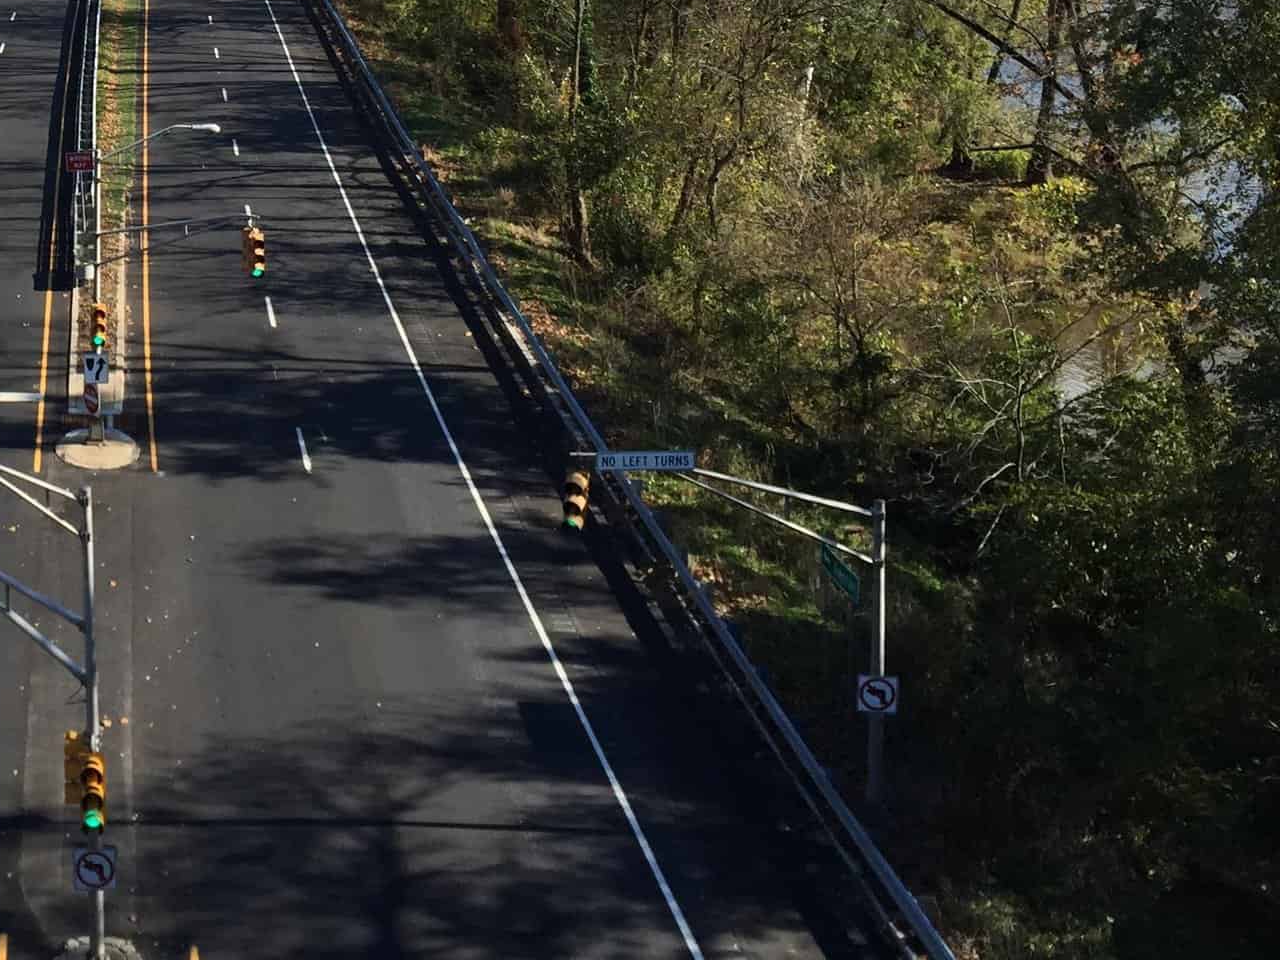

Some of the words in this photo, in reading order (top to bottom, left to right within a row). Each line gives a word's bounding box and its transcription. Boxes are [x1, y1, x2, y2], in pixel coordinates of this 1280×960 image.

[601, 455, 616, 467] NO
[622, 455, 647, 468] LEFT
[654, 455, 689, 467] TURNS
